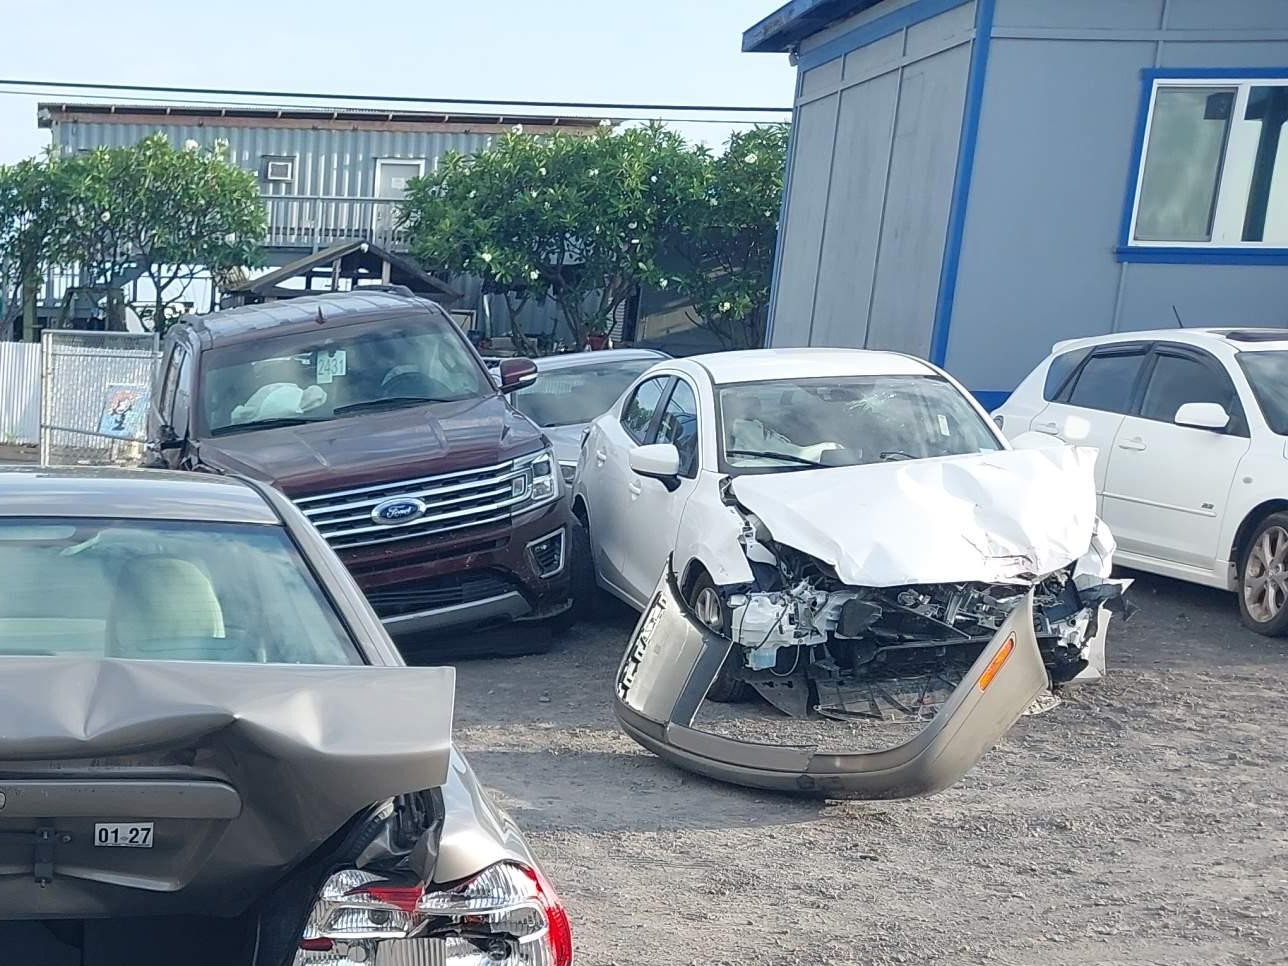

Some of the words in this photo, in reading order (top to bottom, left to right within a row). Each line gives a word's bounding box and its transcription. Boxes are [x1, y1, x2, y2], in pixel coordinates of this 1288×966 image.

[386, 504, 413, 519] Ford
[98, 827, 119, 843] 01
[128, 827, 152, 843] 27
